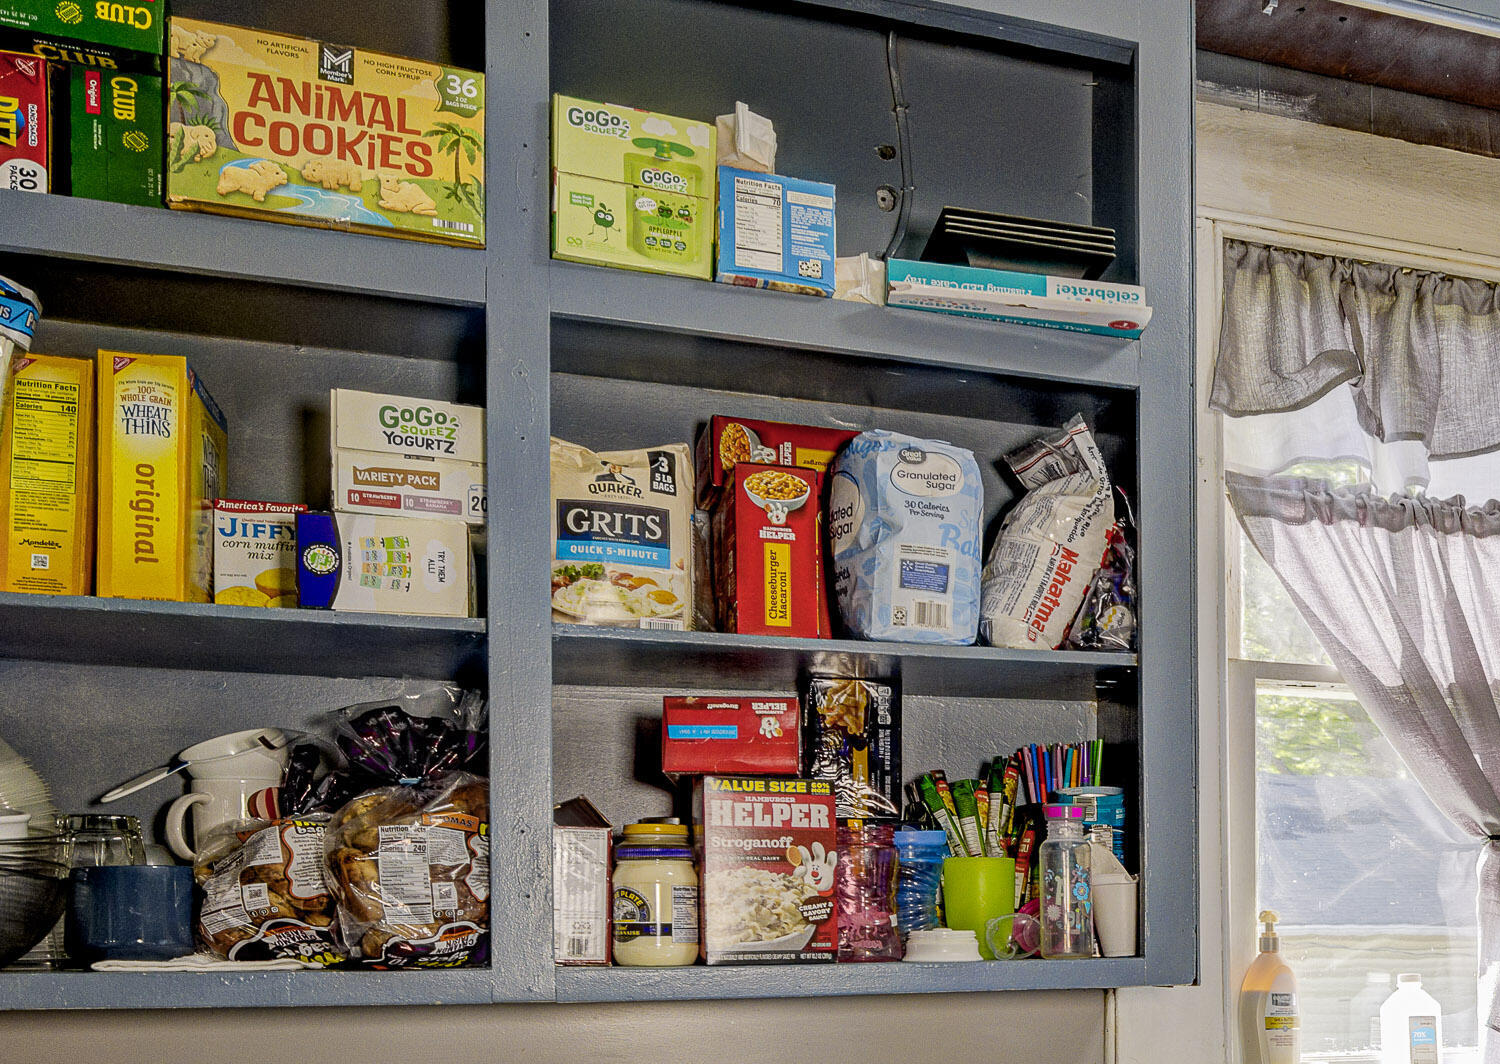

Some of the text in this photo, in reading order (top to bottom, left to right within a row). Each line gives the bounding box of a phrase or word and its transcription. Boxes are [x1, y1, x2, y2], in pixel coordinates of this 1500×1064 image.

[95, 1, 152, 30] CLUB
[266, 48, 300, 59] FLAVORS
[270, 42, 309, 54] ARTIFICIAL
[33, 44, 119, 70] CLUB
[320, 67, 353, 80] Member's
[364, 58, 433, 77] NO HIGH FRUCTOSE
[376, 68, 421, 81] CORN SYRUP
[446, 74, 478, 98] 36
[88, 79, 98, 107] Original
[111, 77, 139, 121] CLUB
[446, 100, 461, 108] BAGS
[568, 107, 621, 126] GoGo
[10, 165, 18, 190] PACKS
[19, 167, 38, 190] 30
[641, 169, 681, 184] GoGo
[736, 178, 781, 191] Nutrition Facts
[736, 196, 758, 204] Calories
[772, 198, 781, 206] 70
[1056, 283, 1141, 301] celebrate!
[16, 380, 53, 390] Nutrition
[54, 384, 78, 392] Facts
[120, 394, 172, 406] WHOLE GRAIN
[16, 402, 77, 413] Calories 140
[120, 404, 172, 421] WHEAT
[378, 404, 448, 428] GoGo
[382, 430, 456, 454] YOGURTZ
[901, 450, 922, 458] Great
[658, 456, 670, 473] 3
[356, 470, 437, 486] VARIETY PACK
[654, 473, 673, 484] 5 LB
[896, 470, 956, 482] Granulated
[588, 483, 642, 498] QUAKER
[652, 482, 675, 493] BAGS
[926, 480, 956, 491] Sugar
[350, 492, 398, 502] 10 STRAWBERRY
[405, 498, 414, 508] 10
[217, 500, 264, 511] America's
[904, 500, 950, 513] 30 Calories
[129, 463, 160, 564] original
[910, 508, 945, 520] Per Serving
[566, 508, 662, 540] GRITS
[759, 530, 796, 542] HELPER
[222, 540, 296, 552] corn muffin
[570, 544, 658, 561] QUICK 5-MINUTE
[247, 550, 275, 560] mix
[437, 550, 446, 584] TRY THEM
[768, 550, 778, 620] Cheeseburger
[1032, 547, 1080, 632] Mahatma
[778, 572, 788, 620] Macaroni
[751, 702, 788, 711] HELPER
[710, 780, 766, 792] VALUE
[769, 780, 807, 793] SIZE
[710, 800, 830, 828] HELPER
[414, 844, 427, 852] 240
[710, 836, 794, 851] Stroganoff
[620, 890, 644, 907] PLATE
[798, 902, 827, 912] CREAMY
[802, 908, 832, 917] SAVORY
